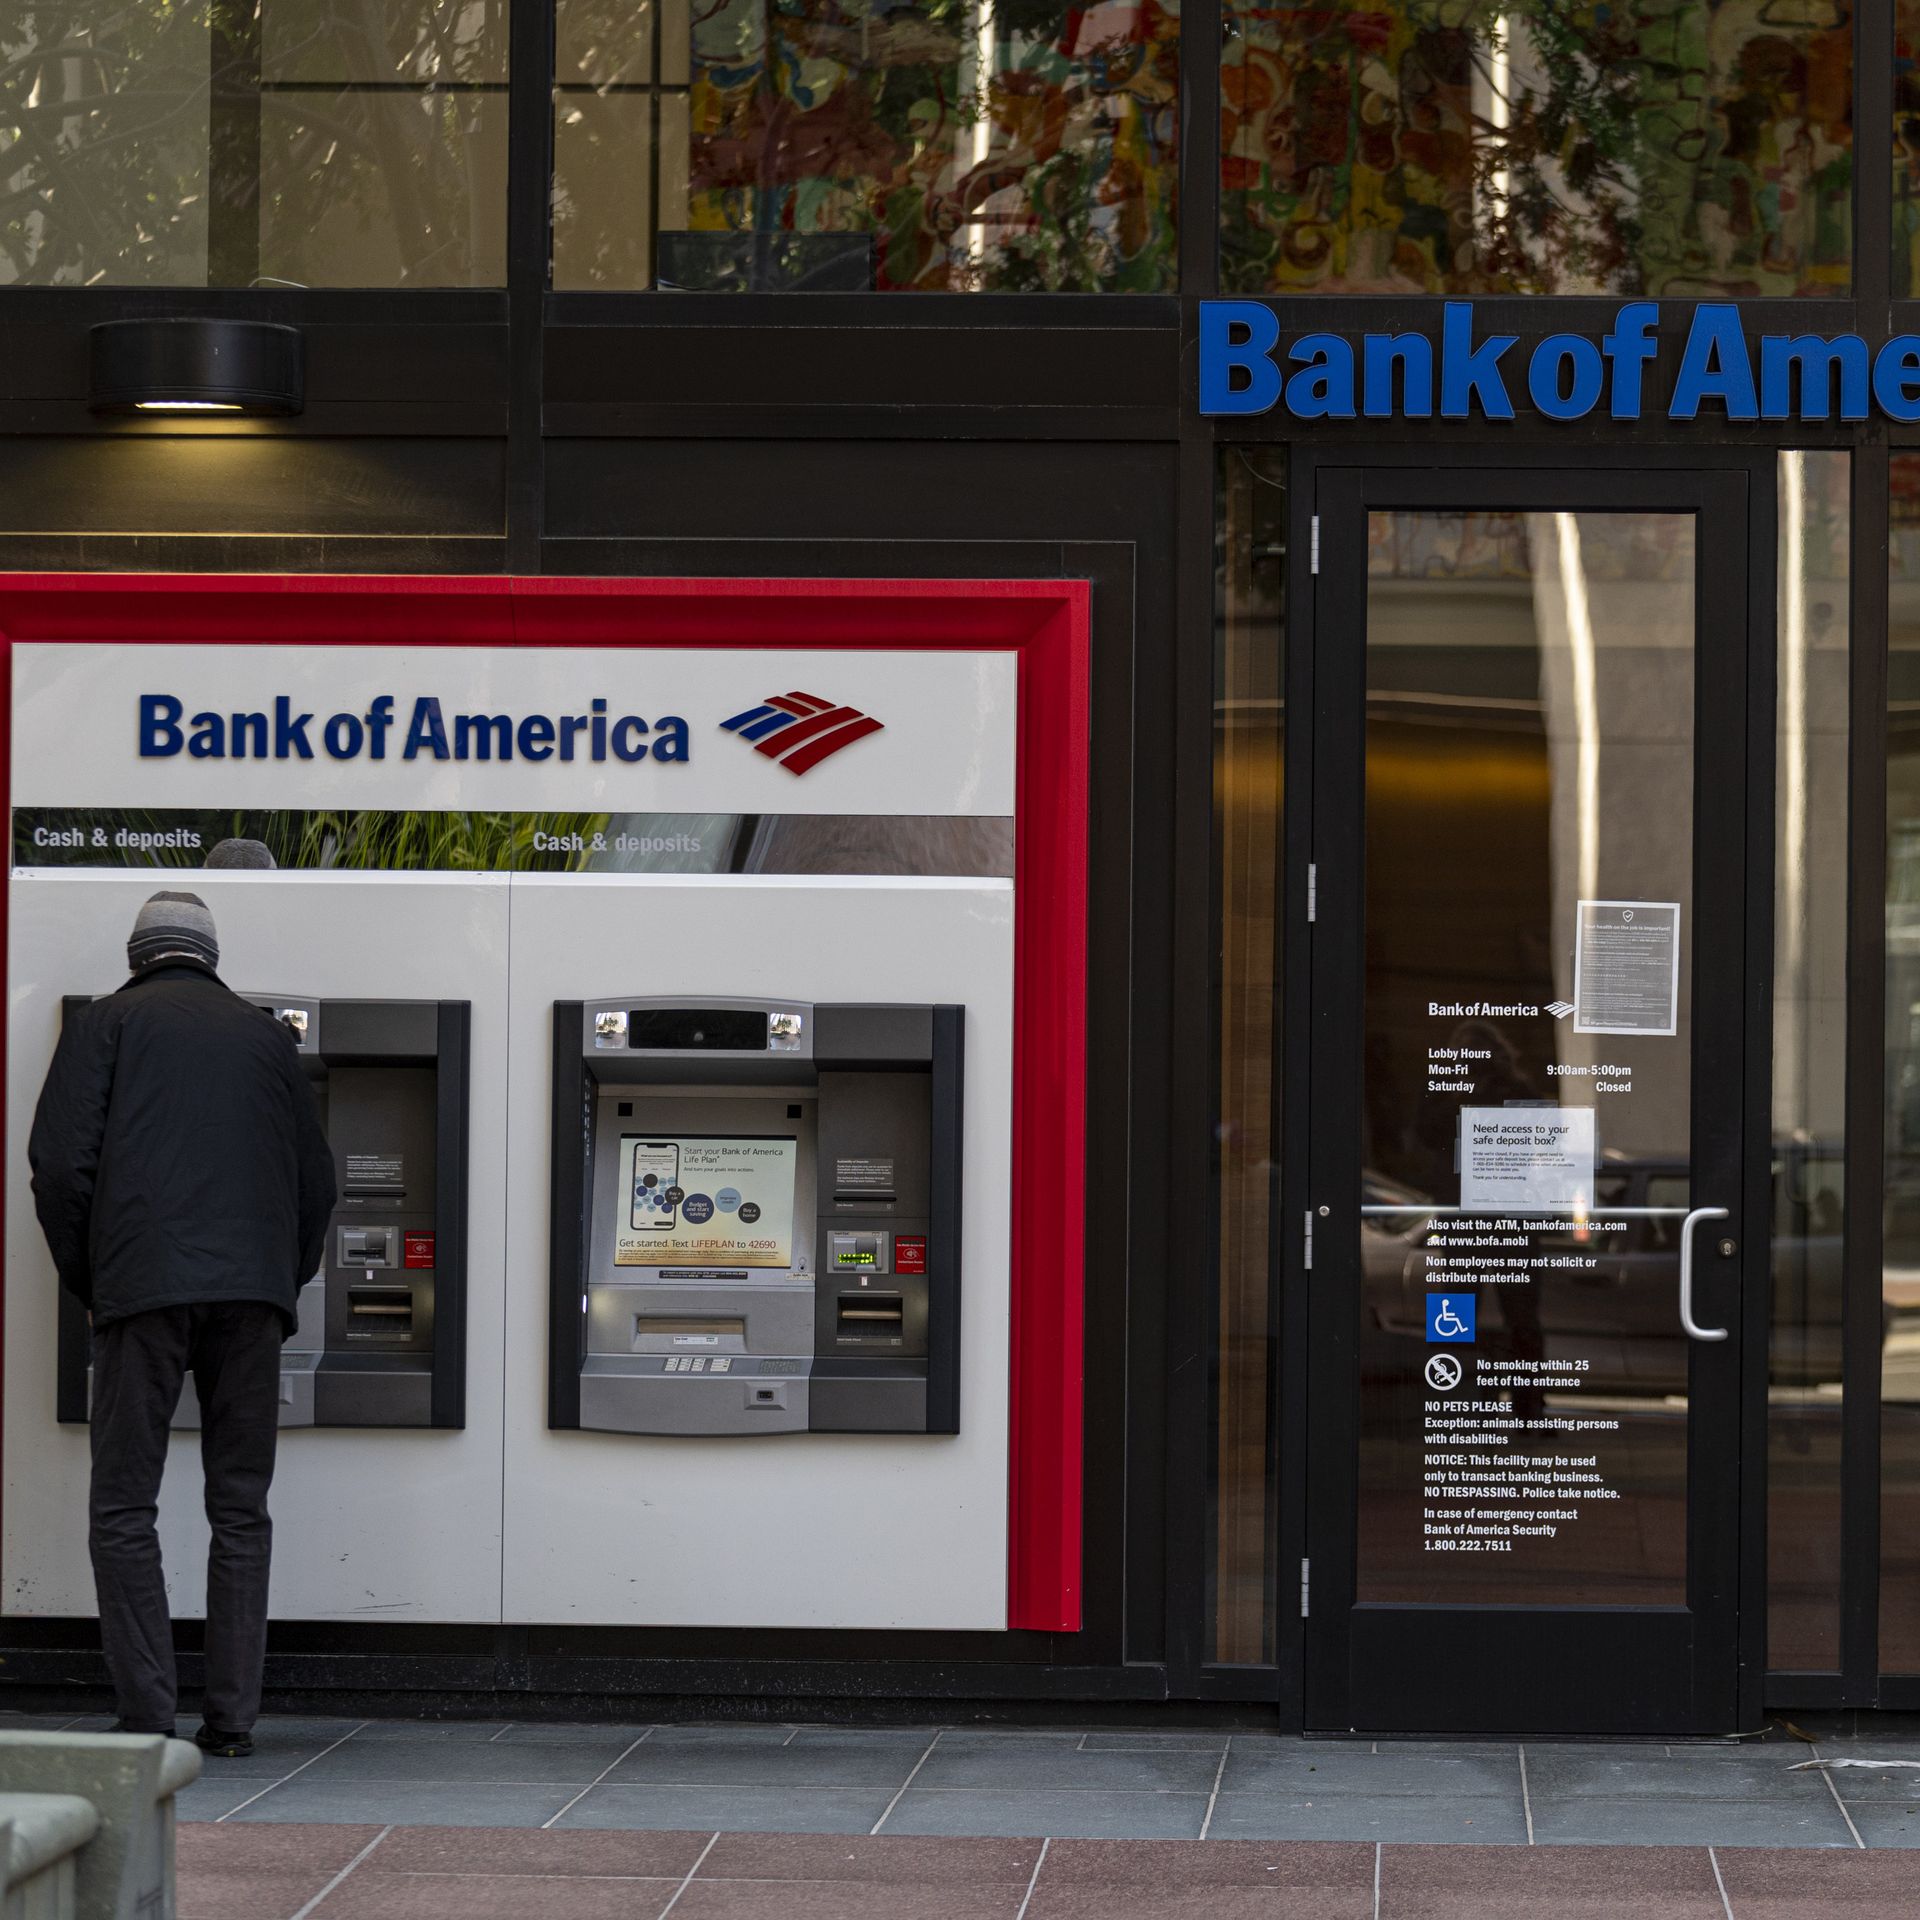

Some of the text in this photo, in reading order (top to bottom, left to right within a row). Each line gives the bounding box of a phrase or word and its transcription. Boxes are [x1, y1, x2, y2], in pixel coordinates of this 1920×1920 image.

[1200, 300, 1519, 418] Bank
[1528, 302, 1658, 418] of
[138, 694, 690, 764] Bank of America
[34, 828, 201, 851] Cash & deposits
[533, 832, 701, 856] Cash & deposits
[1429, 1002, 1538, 1016] Bank of America
[1428, 1048, 1491, 1060] Lobby Hours
[1428, 1064, 1468, 1074] Mon-Fri
[1547, 1064, 1631, 1077] 9:00am-5:00pm
[1428, 1080, 1475, 1093] Saturday
[1596, 1082, 1631, 1092] Closed
[1473, 1124, 1498, 1133] Need
[1536, 1126, 1546, 1134] to
[1548, 1126, 1569, 1136] your
[1473, 1136, 1556, 1147] safe deposit box?
[1427, 1220, 1627, 1232] Also visit the ATM, bankofamerica.com
[619, 1239, 634, 1247] Get
[636, 1240, 669, 1248] started.
[672, 1240, 688, 1248] Text
[691, 1240, 734, 1248] LIFEPLAN
[748, 1240, 776, 1248] 42690
[1426, 1235, 1528, 1246] and www.bofa.mobi
[1426, 1256, 1597, 1269] Non employees may not solicit or
[1426, 1272, 1530, 1283] distribute materials
[1477, 1360, 1589, 1372] No smoking within 25
[1476, 1375, 1580, 1386] feet of the entrance
[1425, 1400, 1512, 1412] NO PETS PLEASE
[1425, 1417, 1619, 1431] Exception: animals assisting persons
[1424, 1433, 1508, 1444] with disabilities
[1425, 1454, 1596, 1468] NOTICE: This facility may be used
[1424, 1470, 1603, 1484] only to transact banking business.
[1424, 1486, 1620, 1498] NO TRESPASSING. Police take notice.
[1424, 1508, 1578, 1521] In case of emergency contact
[1424, 1524, 1556, 1538] Bank of America Security
[1424, 1540, 1512, 1551] 1.800.222.7511
